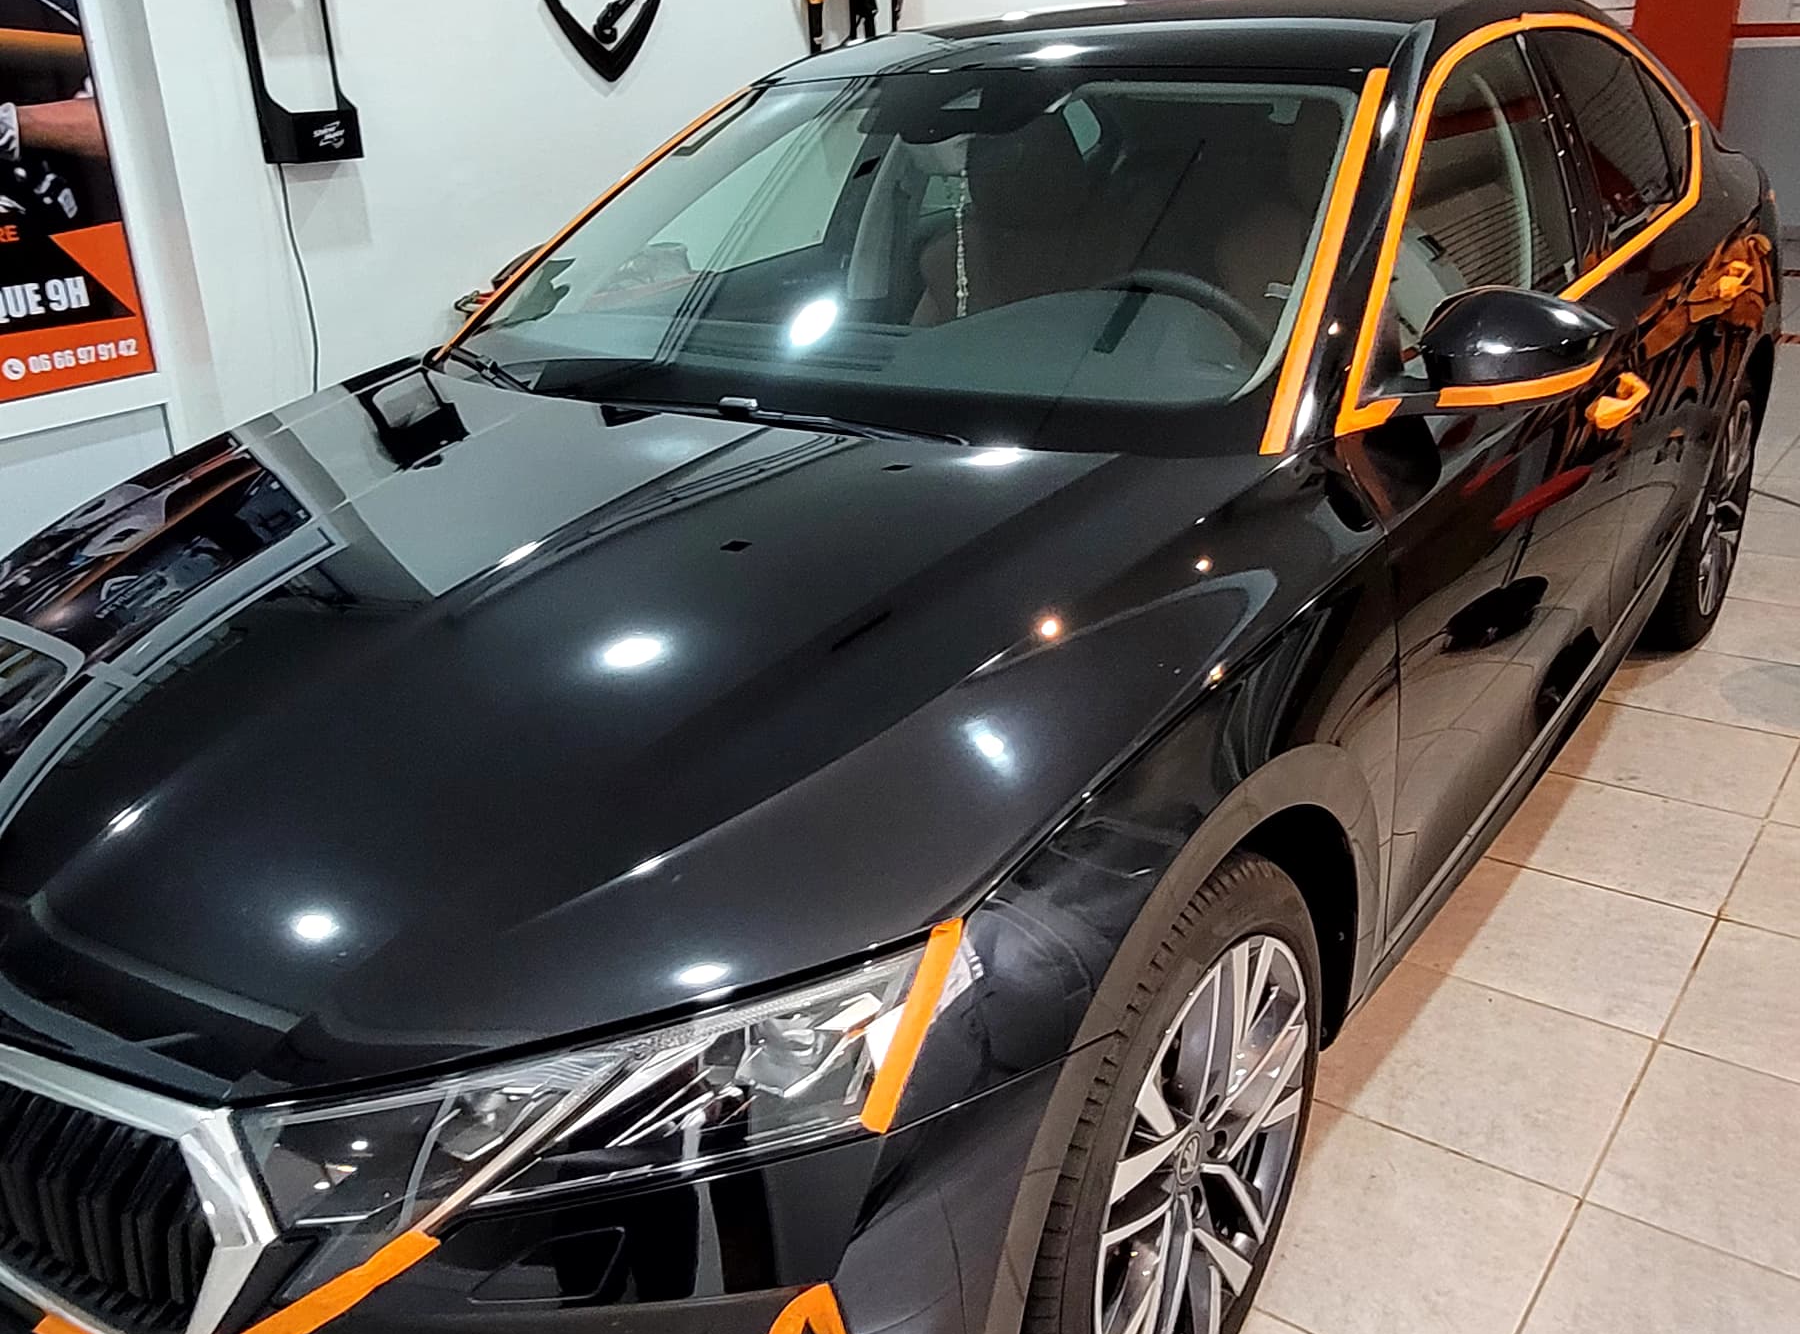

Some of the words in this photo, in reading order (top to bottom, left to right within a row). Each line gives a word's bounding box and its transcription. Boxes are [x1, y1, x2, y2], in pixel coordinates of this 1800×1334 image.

[45, 276, 90, 312] 9H
[53, 350, 77, 369] 66
[77, 345, 96, 365] 97
[97, 342, 117, 361] 91
[118, 338, 139, 356] 42
